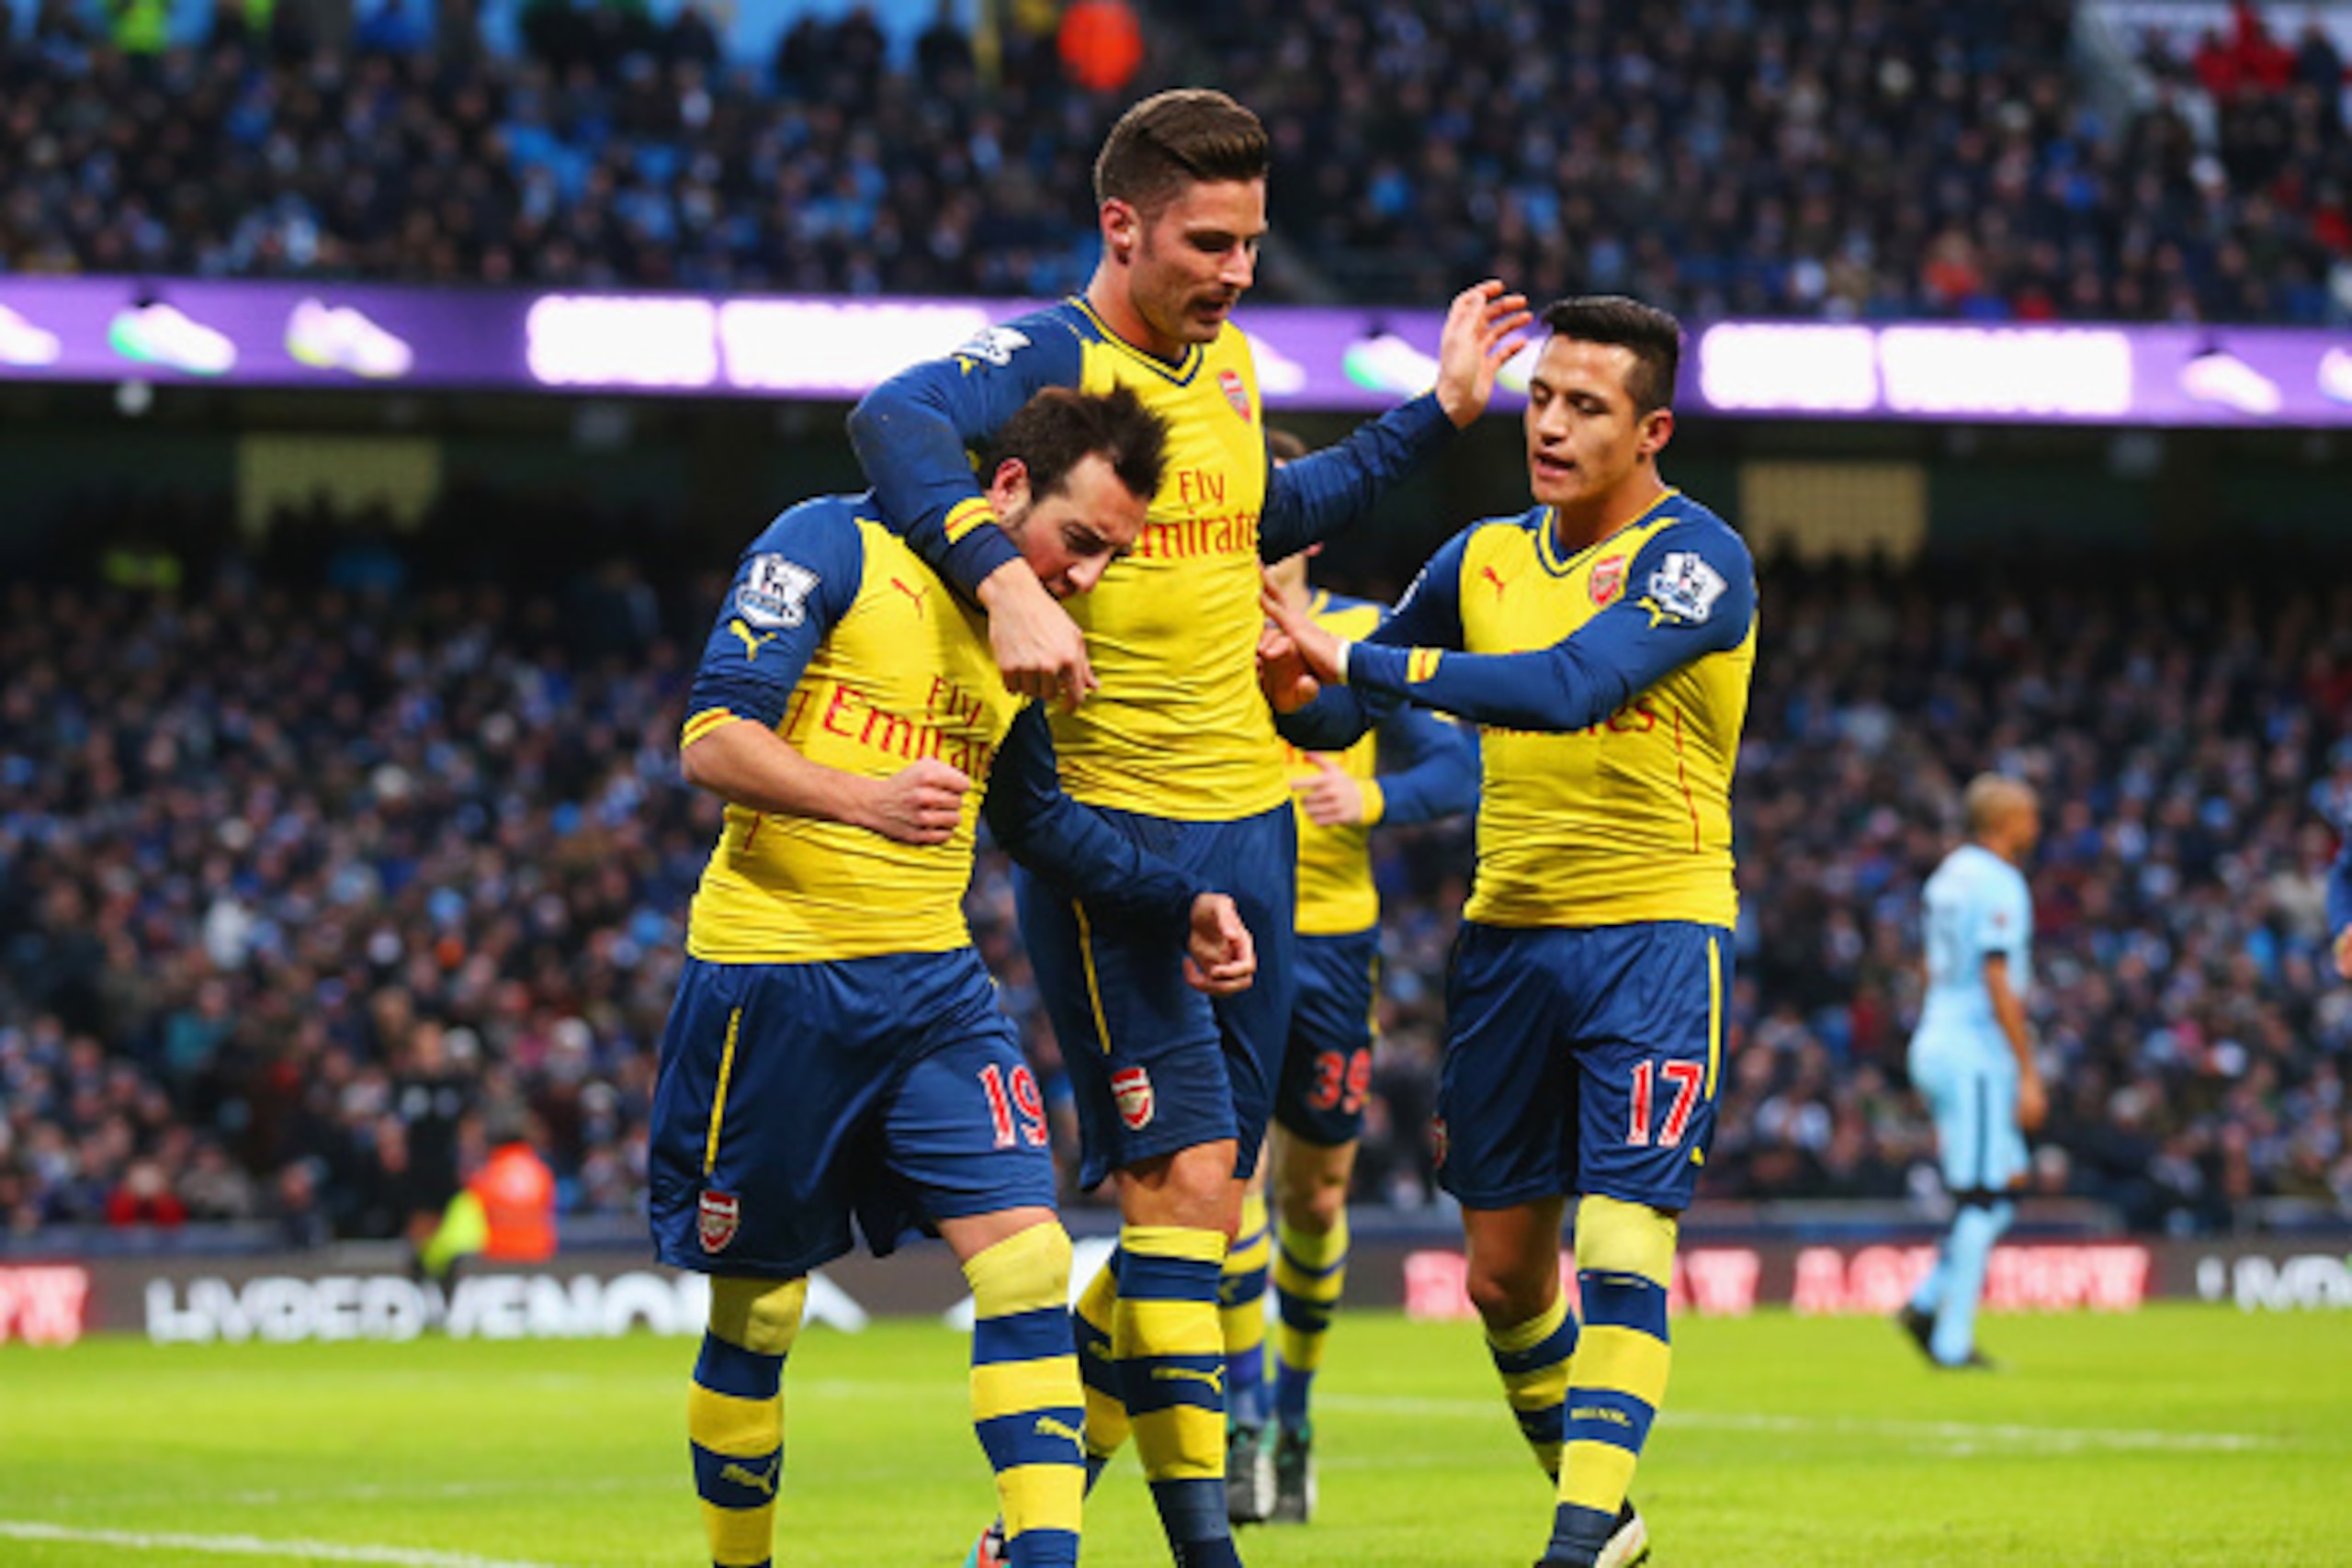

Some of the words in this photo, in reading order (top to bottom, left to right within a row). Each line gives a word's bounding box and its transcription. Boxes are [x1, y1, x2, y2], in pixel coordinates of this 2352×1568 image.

[1177, 468, 1224, 506] Fly
[1132, 509, 1257, 558] mirate
[926, 675, 982, 728] Fly
[977, 1063, 1048, 1150] 19
[1308, 1048, 1372, 1114] 39
[1625, 1059, 1704, 1148] 17
